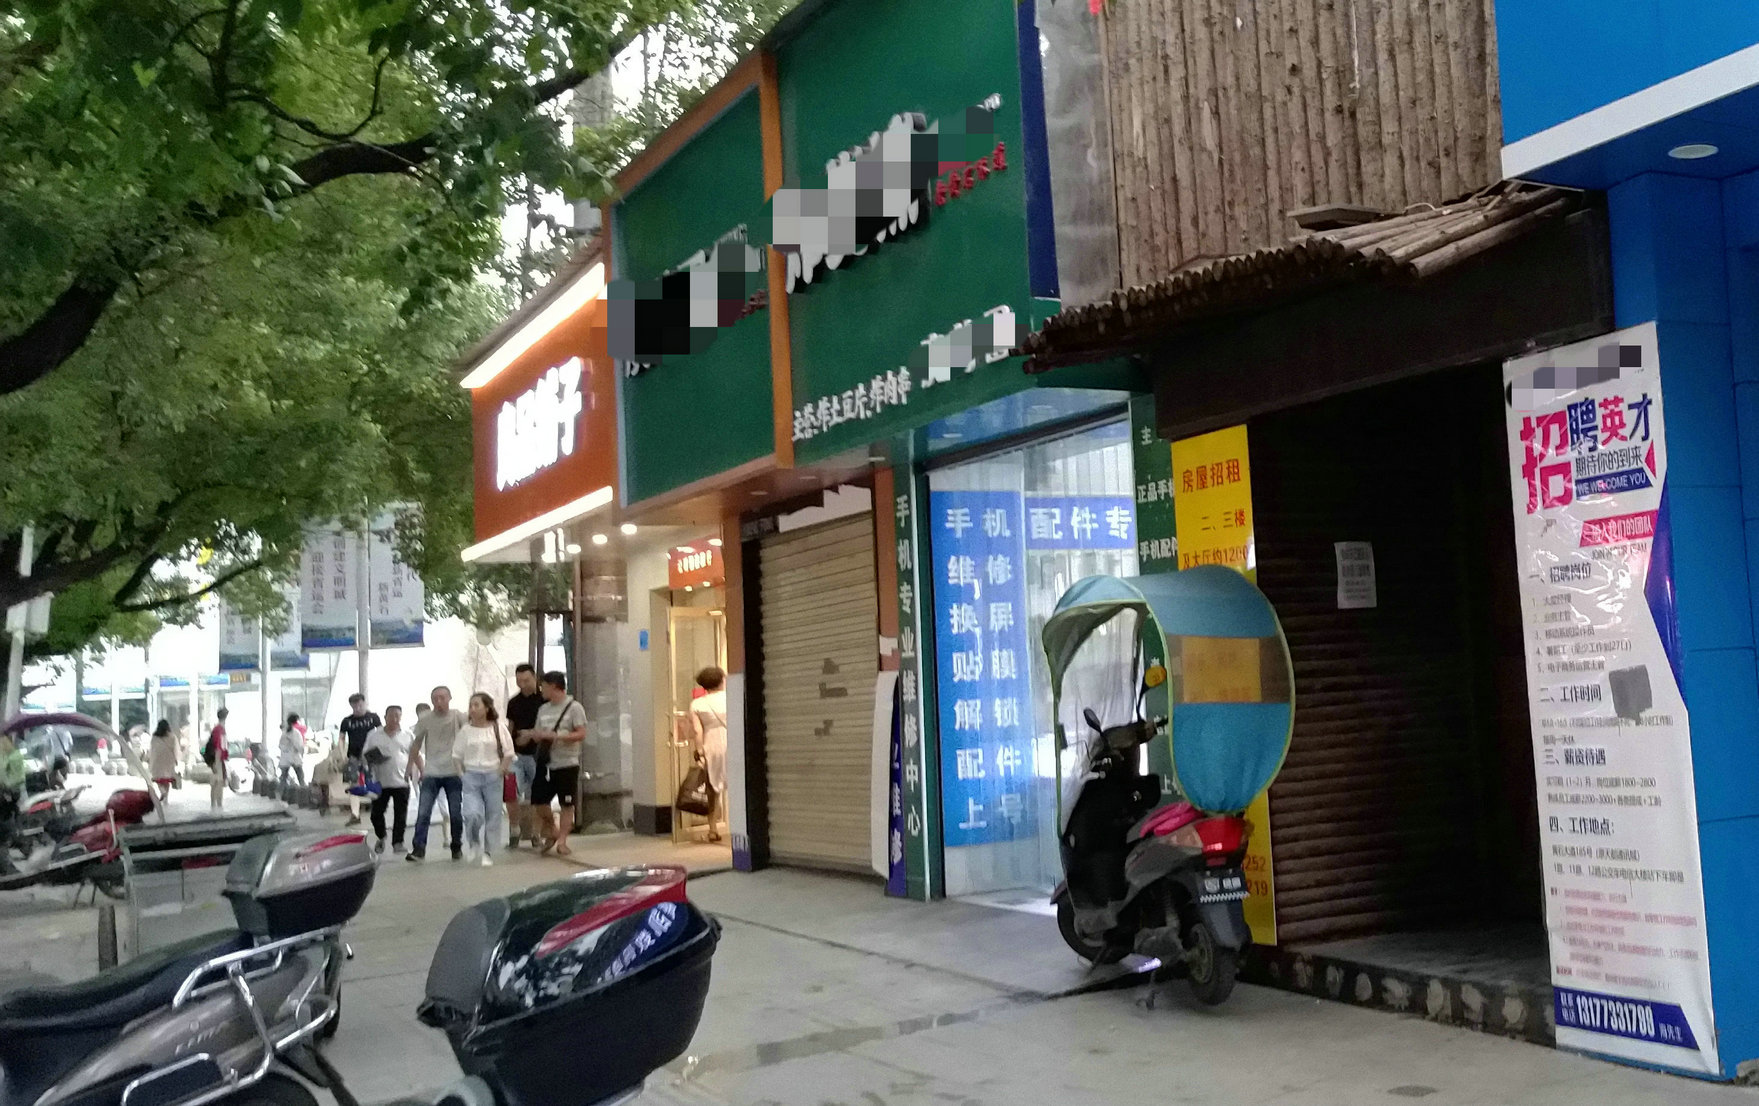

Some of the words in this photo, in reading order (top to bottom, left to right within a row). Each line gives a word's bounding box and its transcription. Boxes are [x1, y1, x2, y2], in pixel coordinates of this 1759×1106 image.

[1519, 393, 1654, 515] 招聘英才
[1575, 445, 1643, 477] 期待你的到来
[1182, 458, 1241, 494] 房屋招租
[1577, 482, 1589, 496] WE
[1590, 475, 1629, 493] WELCOME
[1629, 472, 1647, 486] YOU
[945, 508, 1011, 539] 手机
[1029, 506, 1132, 541] 配件专
[1201, 507, 1246, 531] 二、三楼
[947, 555, 1013, 587] 维修
[950, 602, 1014, 636] 换屏
[896, 494, 921, 838] 手机专业维修中心
[952, 649, 1018, 683] 贴膜
[1538, 683, 1602, 703] 二、工作时间
[953, 697, 1019, 731] 解锁
[956, 744, 1022, 781] 配件
[1543, 748, 1607, 767] 三、薪资待遇
[1549, 815, 1616, 836] 四、工作地点:
[1242, 855, 1267, 872] 252
